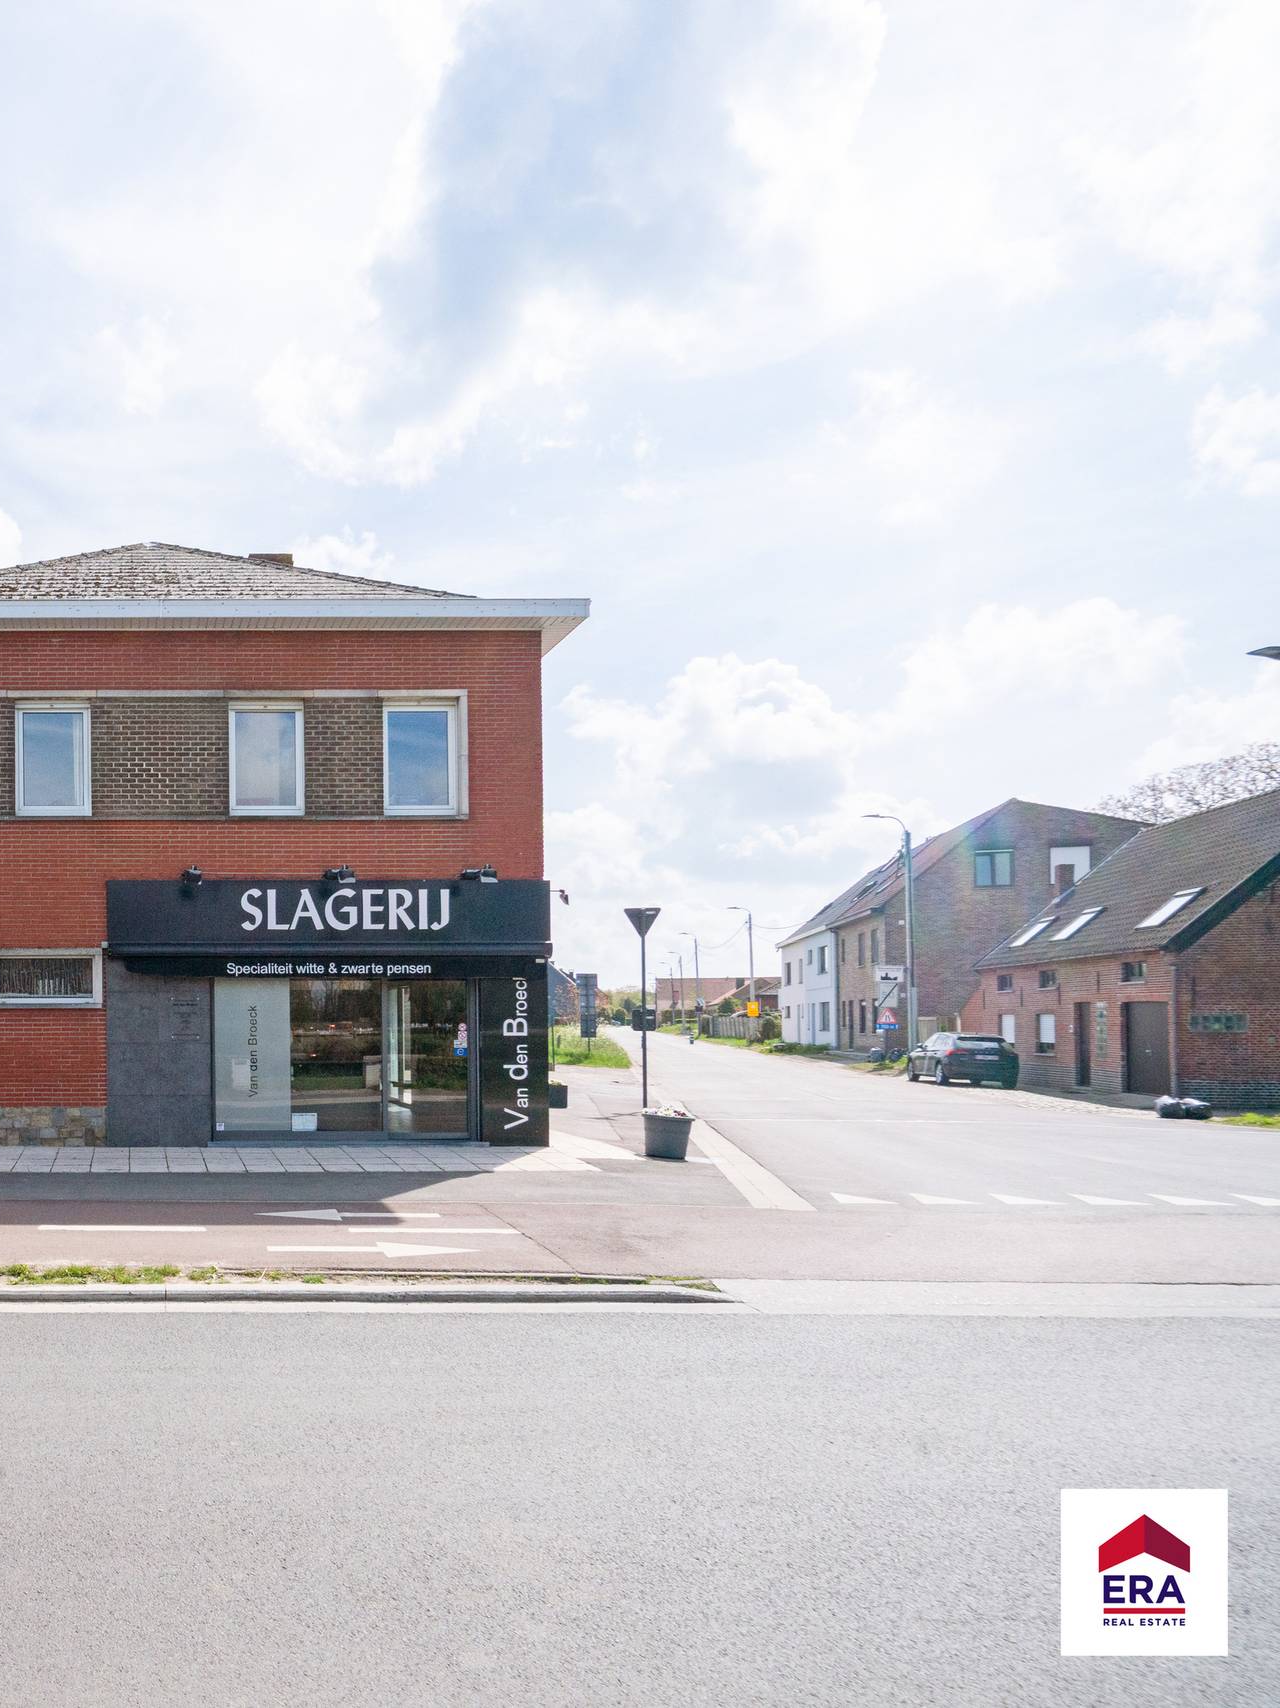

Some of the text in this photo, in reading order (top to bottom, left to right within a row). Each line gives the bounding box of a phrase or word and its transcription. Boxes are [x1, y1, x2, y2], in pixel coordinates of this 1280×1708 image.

[240, 888, 450, 931] SLAGERIJ
[226, 962, 432, 977] Specialiteit witte & zwarte pensen
[248, 1005, 258, 1098] Van den Broeck
[503, 1044, 529, 1081] den
[503, 1088, 529, 1130] Van
